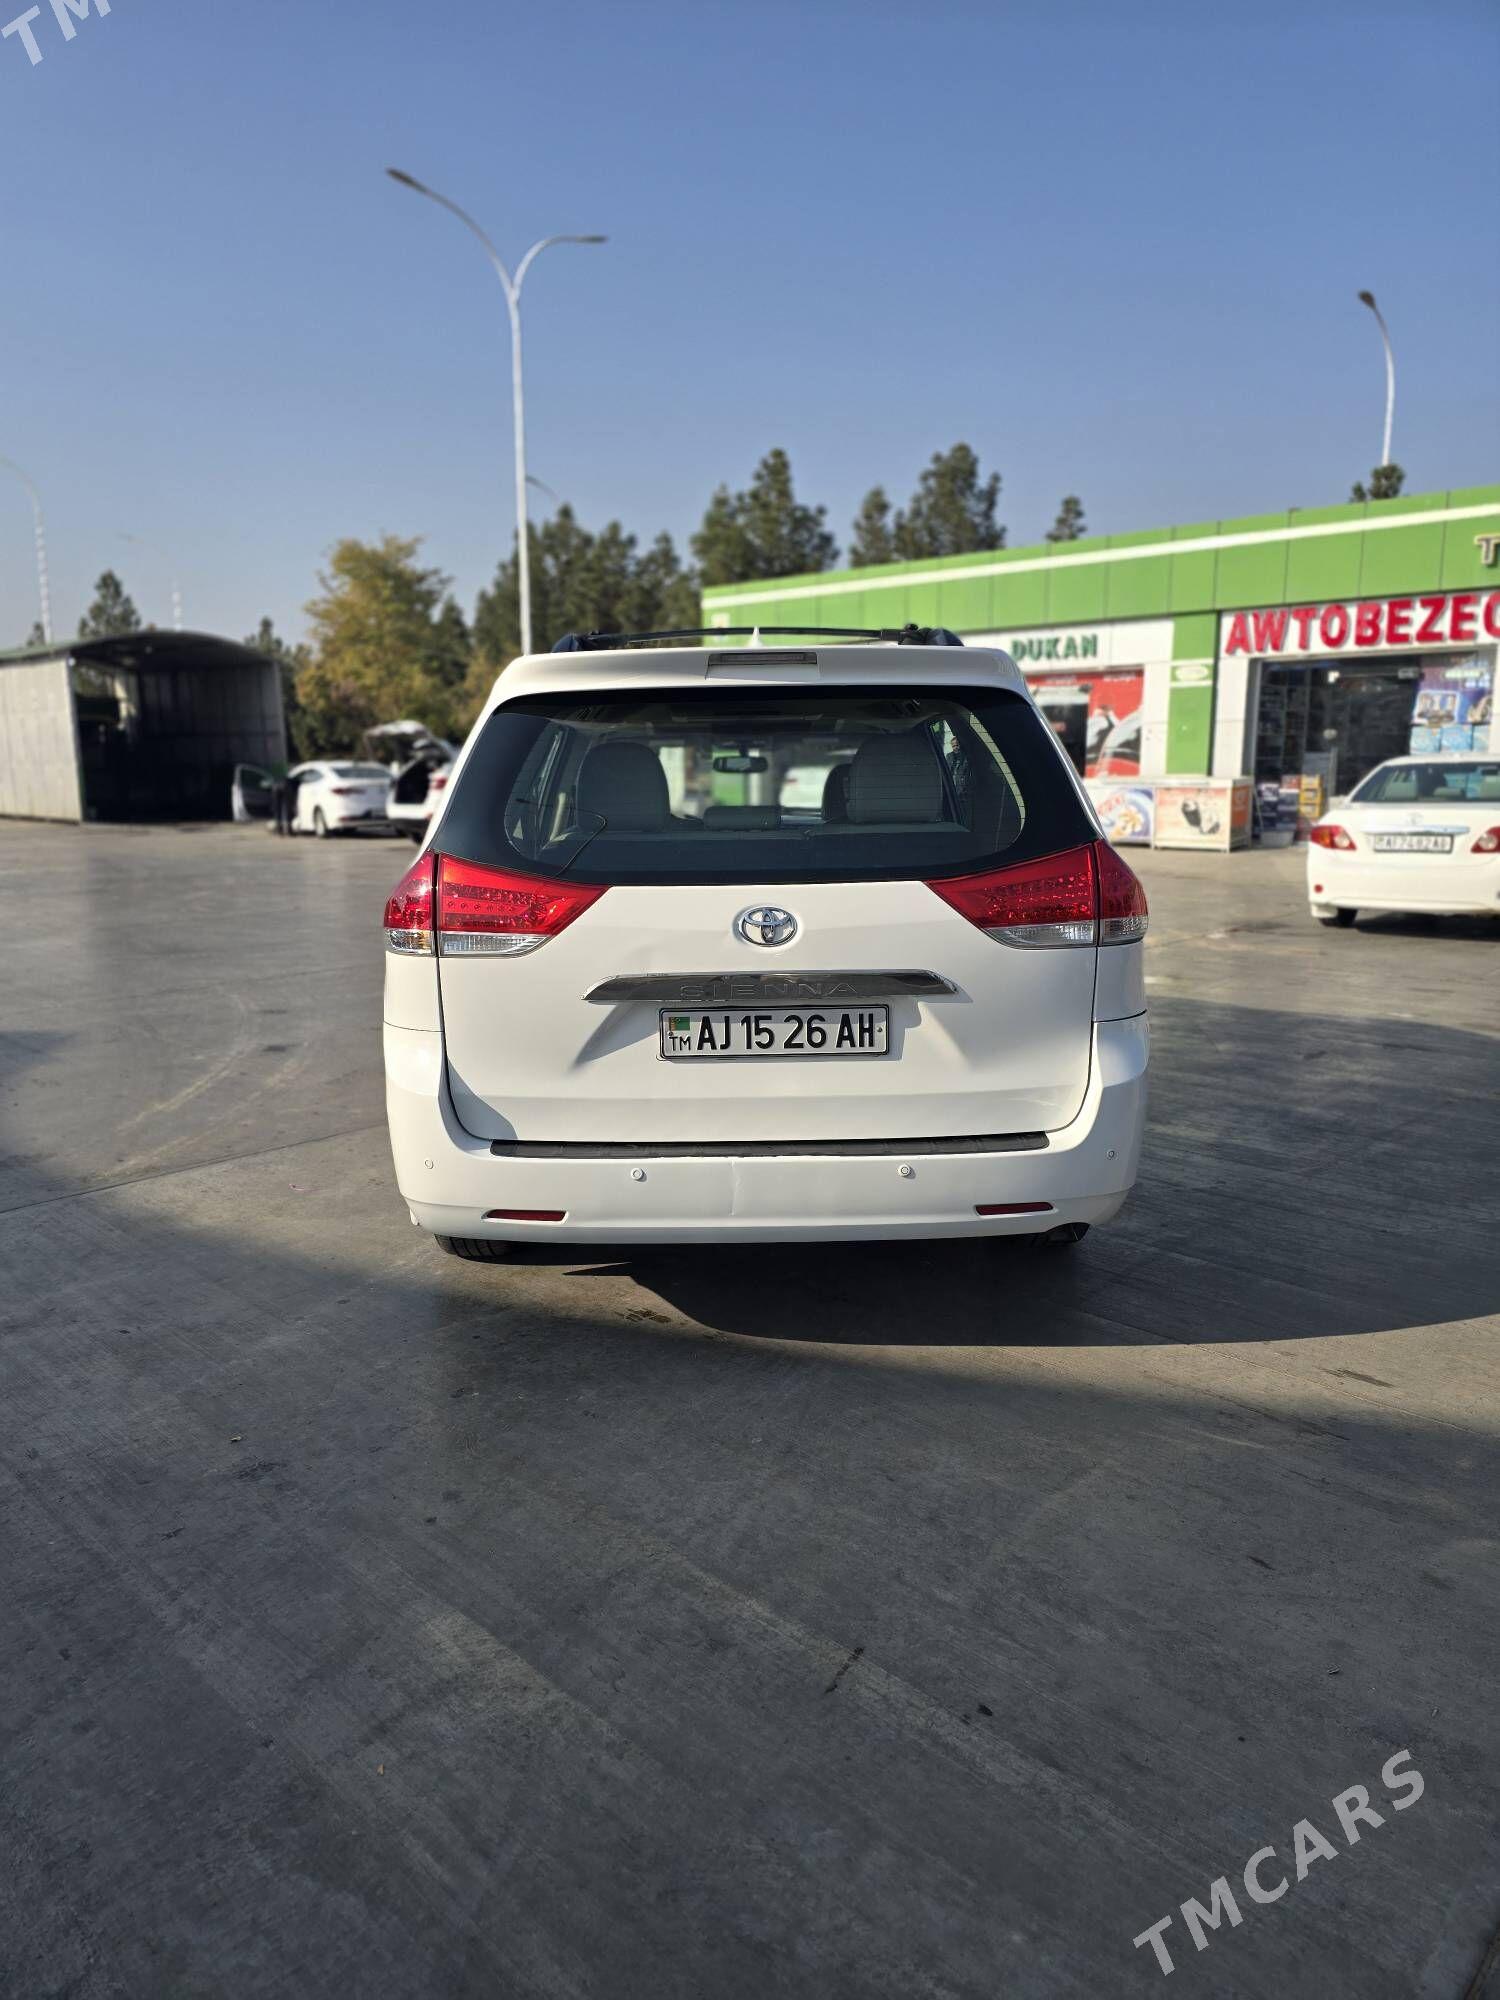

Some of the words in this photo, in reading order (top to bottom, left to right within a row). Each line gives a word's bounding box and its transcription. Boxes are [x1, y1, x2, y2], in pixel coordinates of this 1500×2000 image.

[1011, 633, 1098, 662] DUKAN
[680, 982, 858, 1001] SIENNA
[669, 1036, 691, 1051] TM
[697, 1015, 731, 1051] AJ
[835, 1013, 874, 1048] AH
